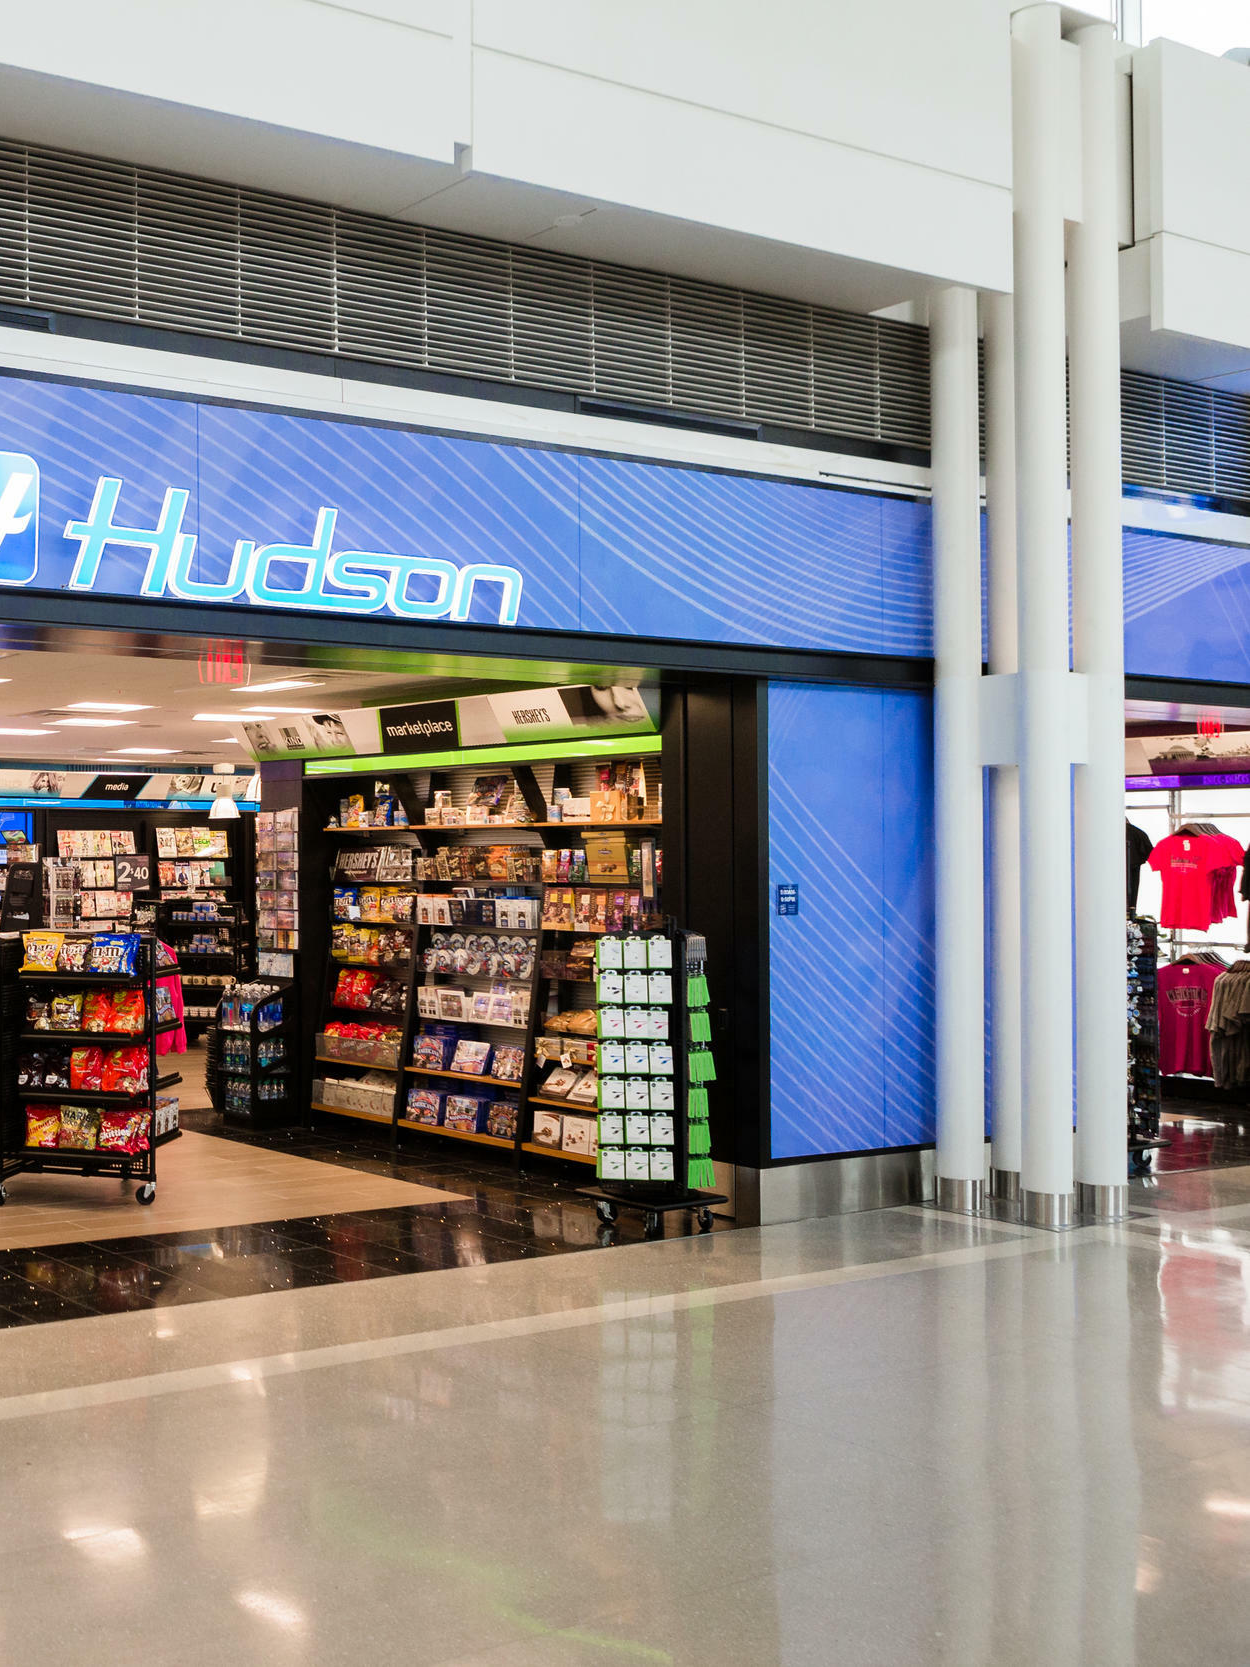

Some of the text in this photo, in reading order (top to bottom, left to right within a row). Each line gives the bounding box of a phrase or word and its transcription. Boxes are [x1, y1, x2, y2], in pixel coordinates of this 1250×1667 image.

[63, 474, 523, 626] Hudson
[511, 708, 551, 725] HERSHEY'S
[386, 720, 453, 738] marketplace
[105, 782, 129, 792] media
[338, 852, 379, 869] HERSHEY'S
